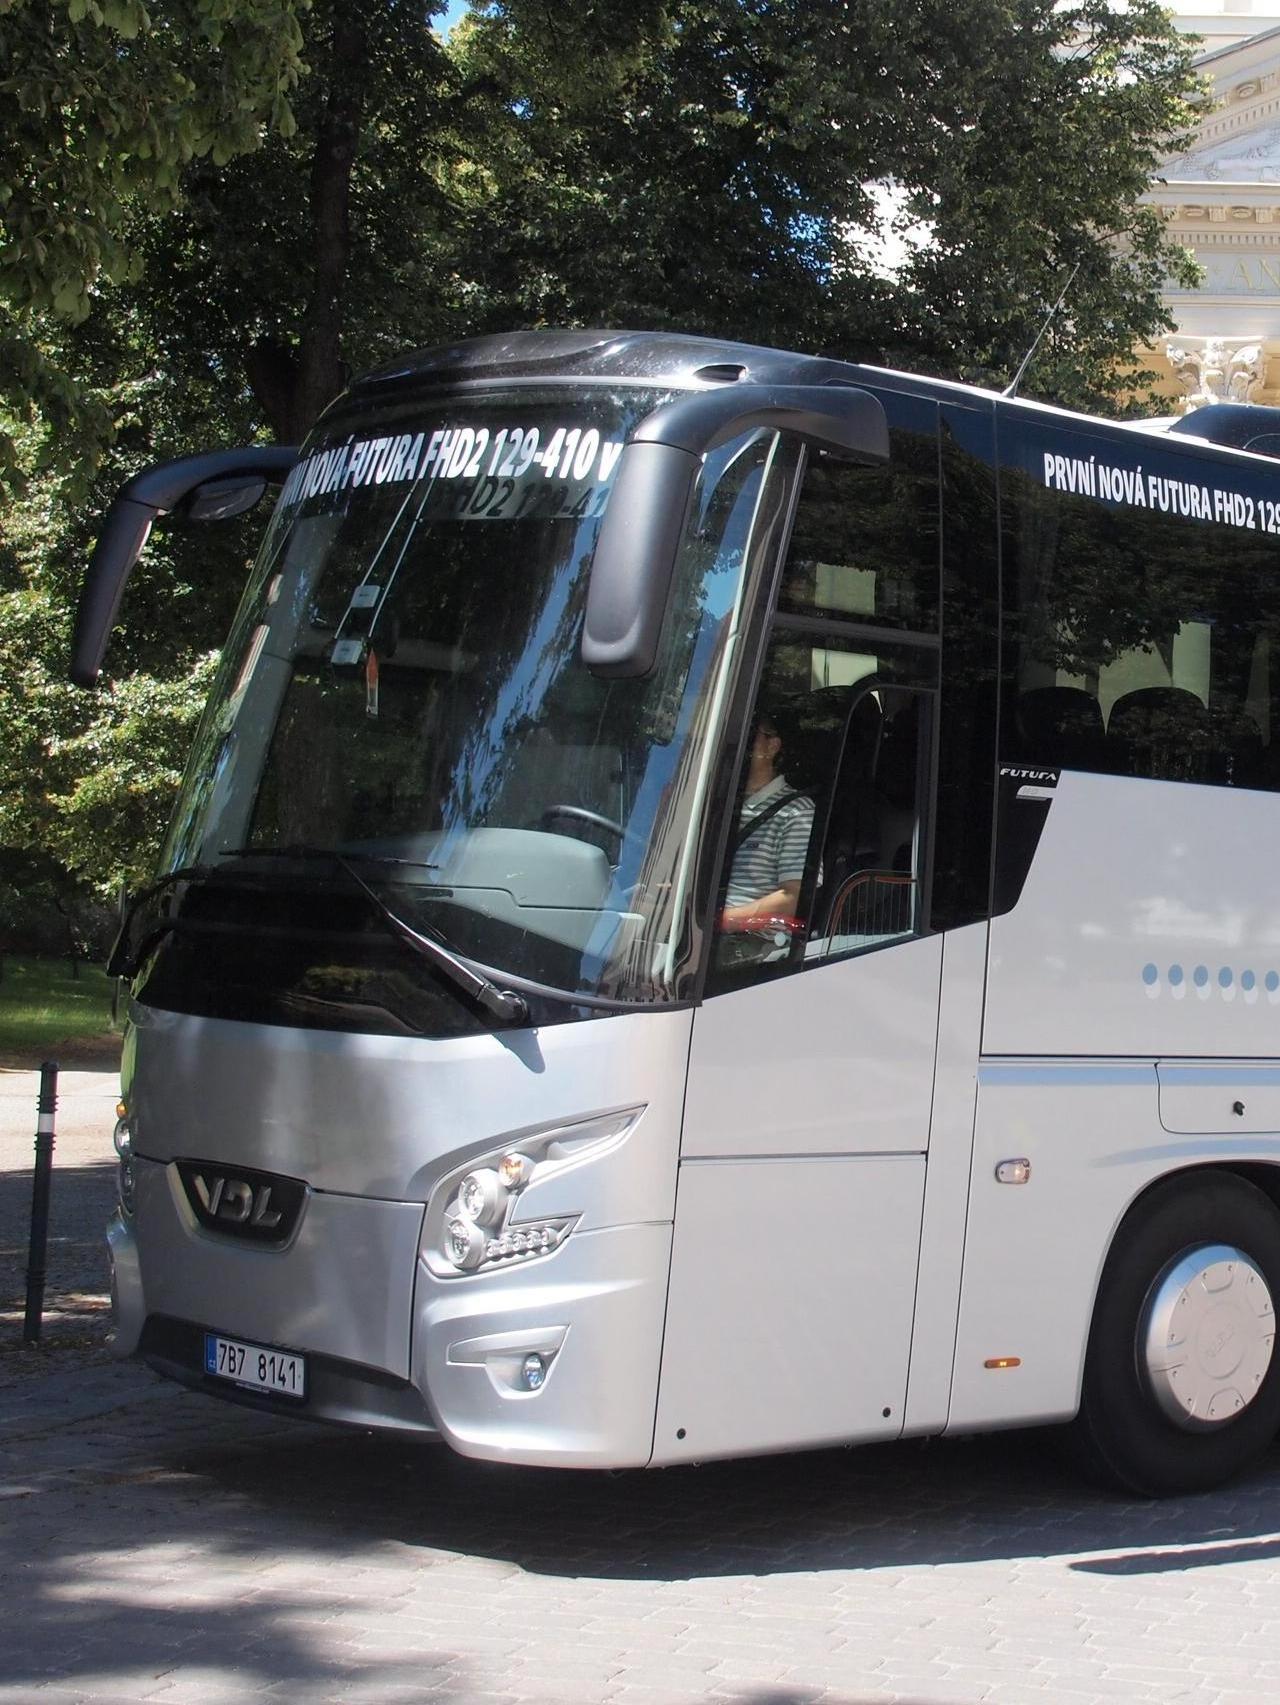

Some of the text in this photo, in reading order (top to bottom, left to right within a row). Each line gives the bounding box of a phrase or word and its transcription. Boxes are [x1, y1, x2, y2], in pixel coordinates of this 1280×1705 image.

[298, 434, 355, 500] NOVÁ
[340, 432, 425, 490] FUTURA
[418, 427, 490, 480] FHD2
[487, 427, 600, 481] 129-410
[1043, 452, 1097, 497] PRVNÍ
[1098, 465, 1147, 508] NOVÁ
[1148, 475, 1213, 521] FUTURA
[1213, 489, 1256, 530] FHD2
[999, 767, 1057, 781] FUTURA
[192, 1173, 283, 1228] VDL
[219, 1343, 297, 1390] 7B7 8141
